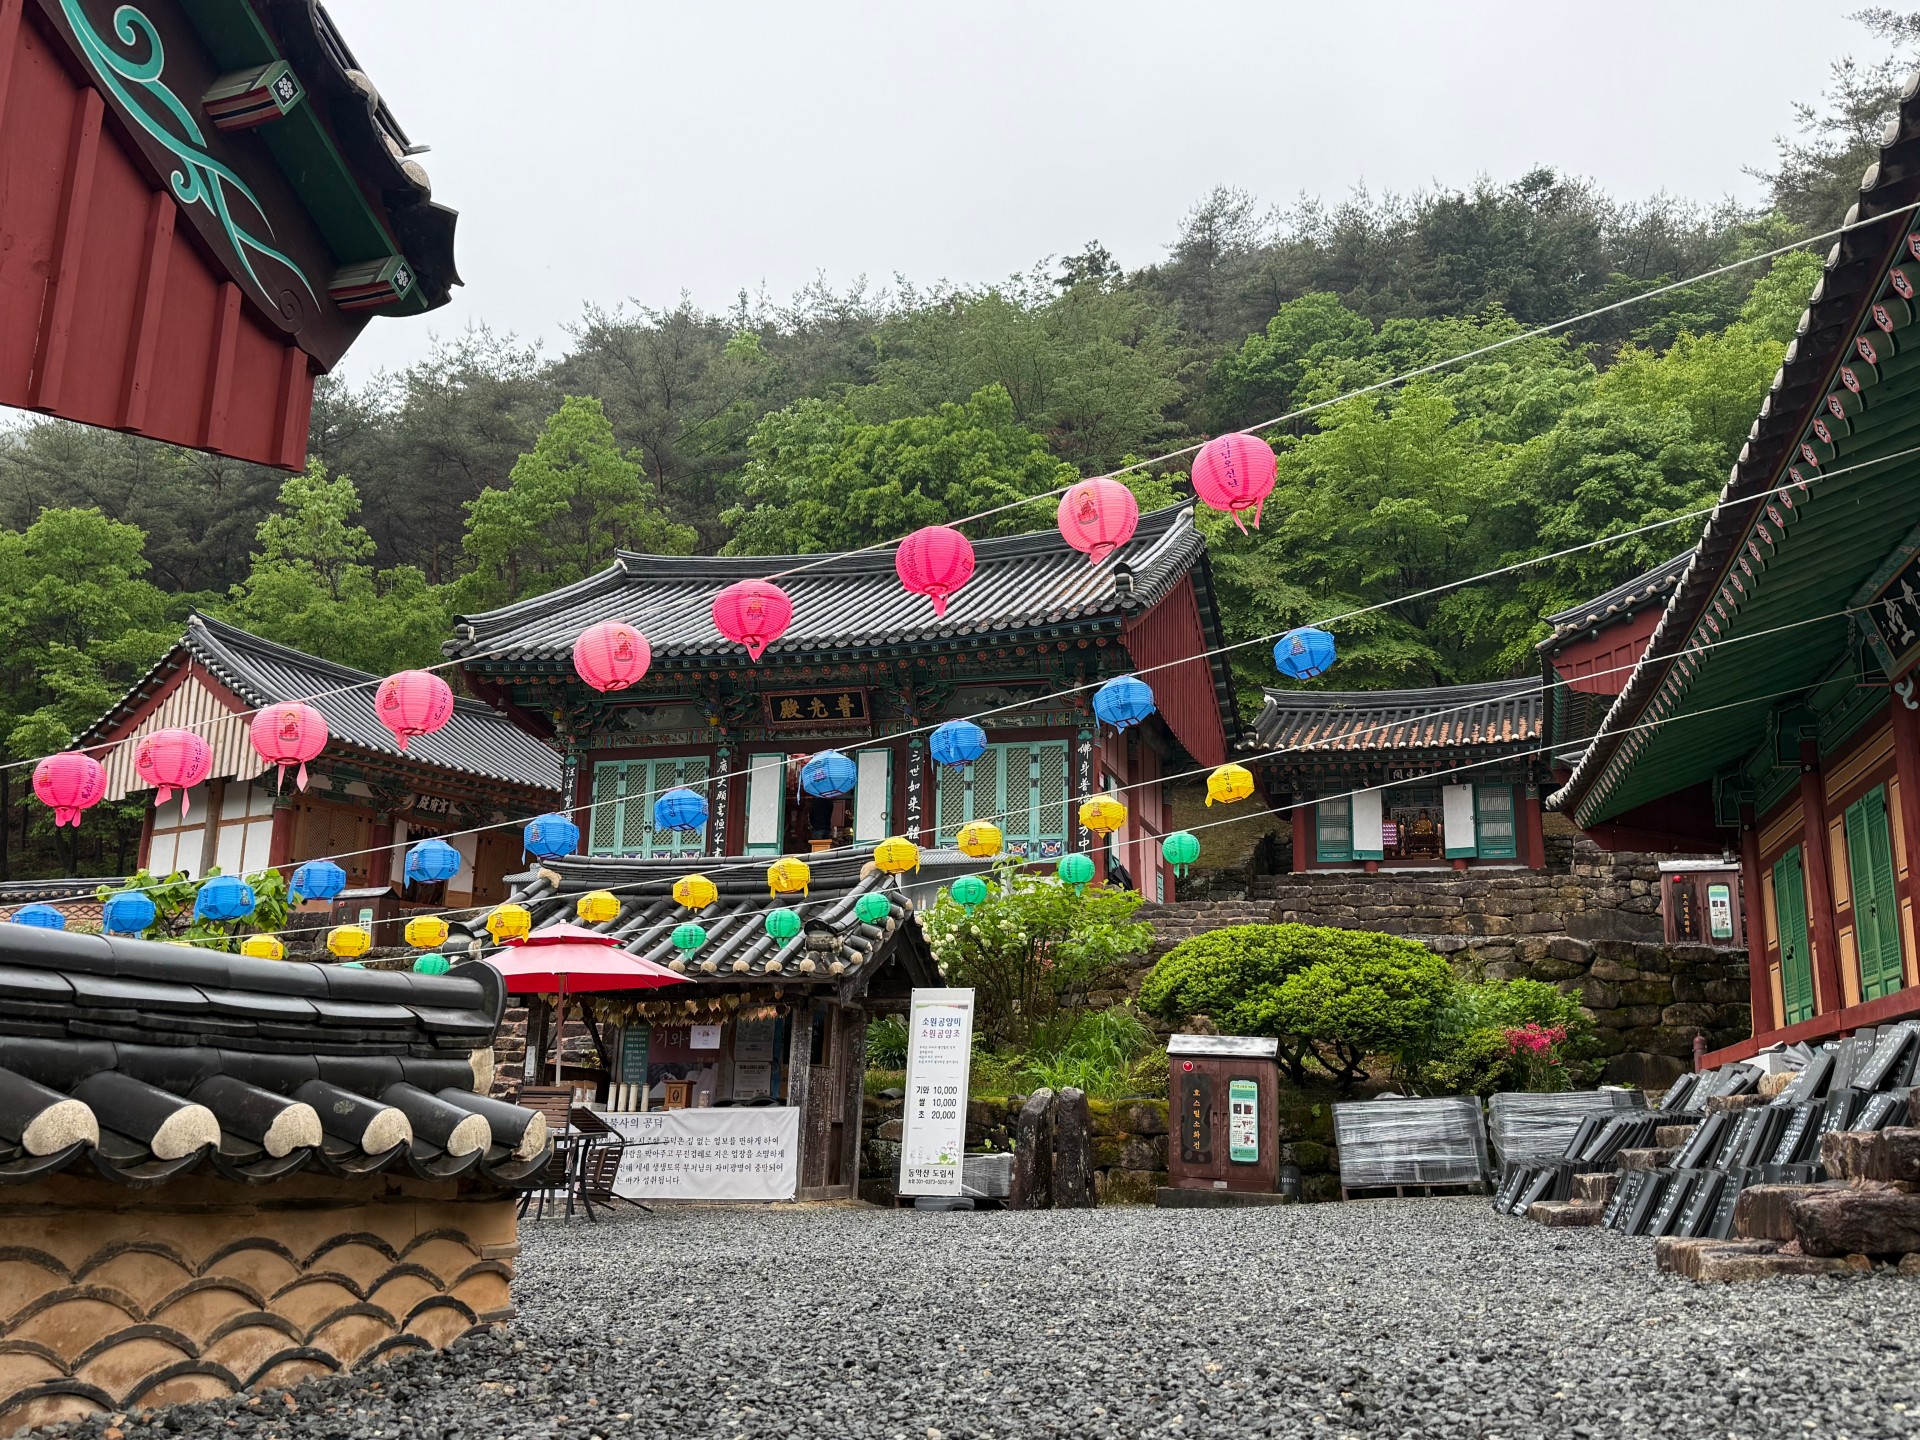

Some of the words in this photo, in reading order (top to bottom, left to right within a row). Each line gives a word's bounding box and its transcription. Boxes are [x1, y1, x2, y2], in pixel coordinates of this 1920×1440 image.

[907, 750, 921, 841] 三世如來一體
[922, 1017, 961, 1027] 소원공양미
[921, 1029, 960, 1038] 소원공양초
[916, 1085, 930, 1095] 기와
[933, 1086, 958, 1095] 10,000
[918, 1098, 926, 1107] 쌀
[932, 1098, 957, 1107] 10,000
[918, 1110, 925, 1119] 초
[931, 1111, 956, 1120] 20,000
[643, 1117, 663, 1129] 공덕
[908, 1168, 930, 1178] 동악산
[932, 1169, 955, 1179] 도림사
